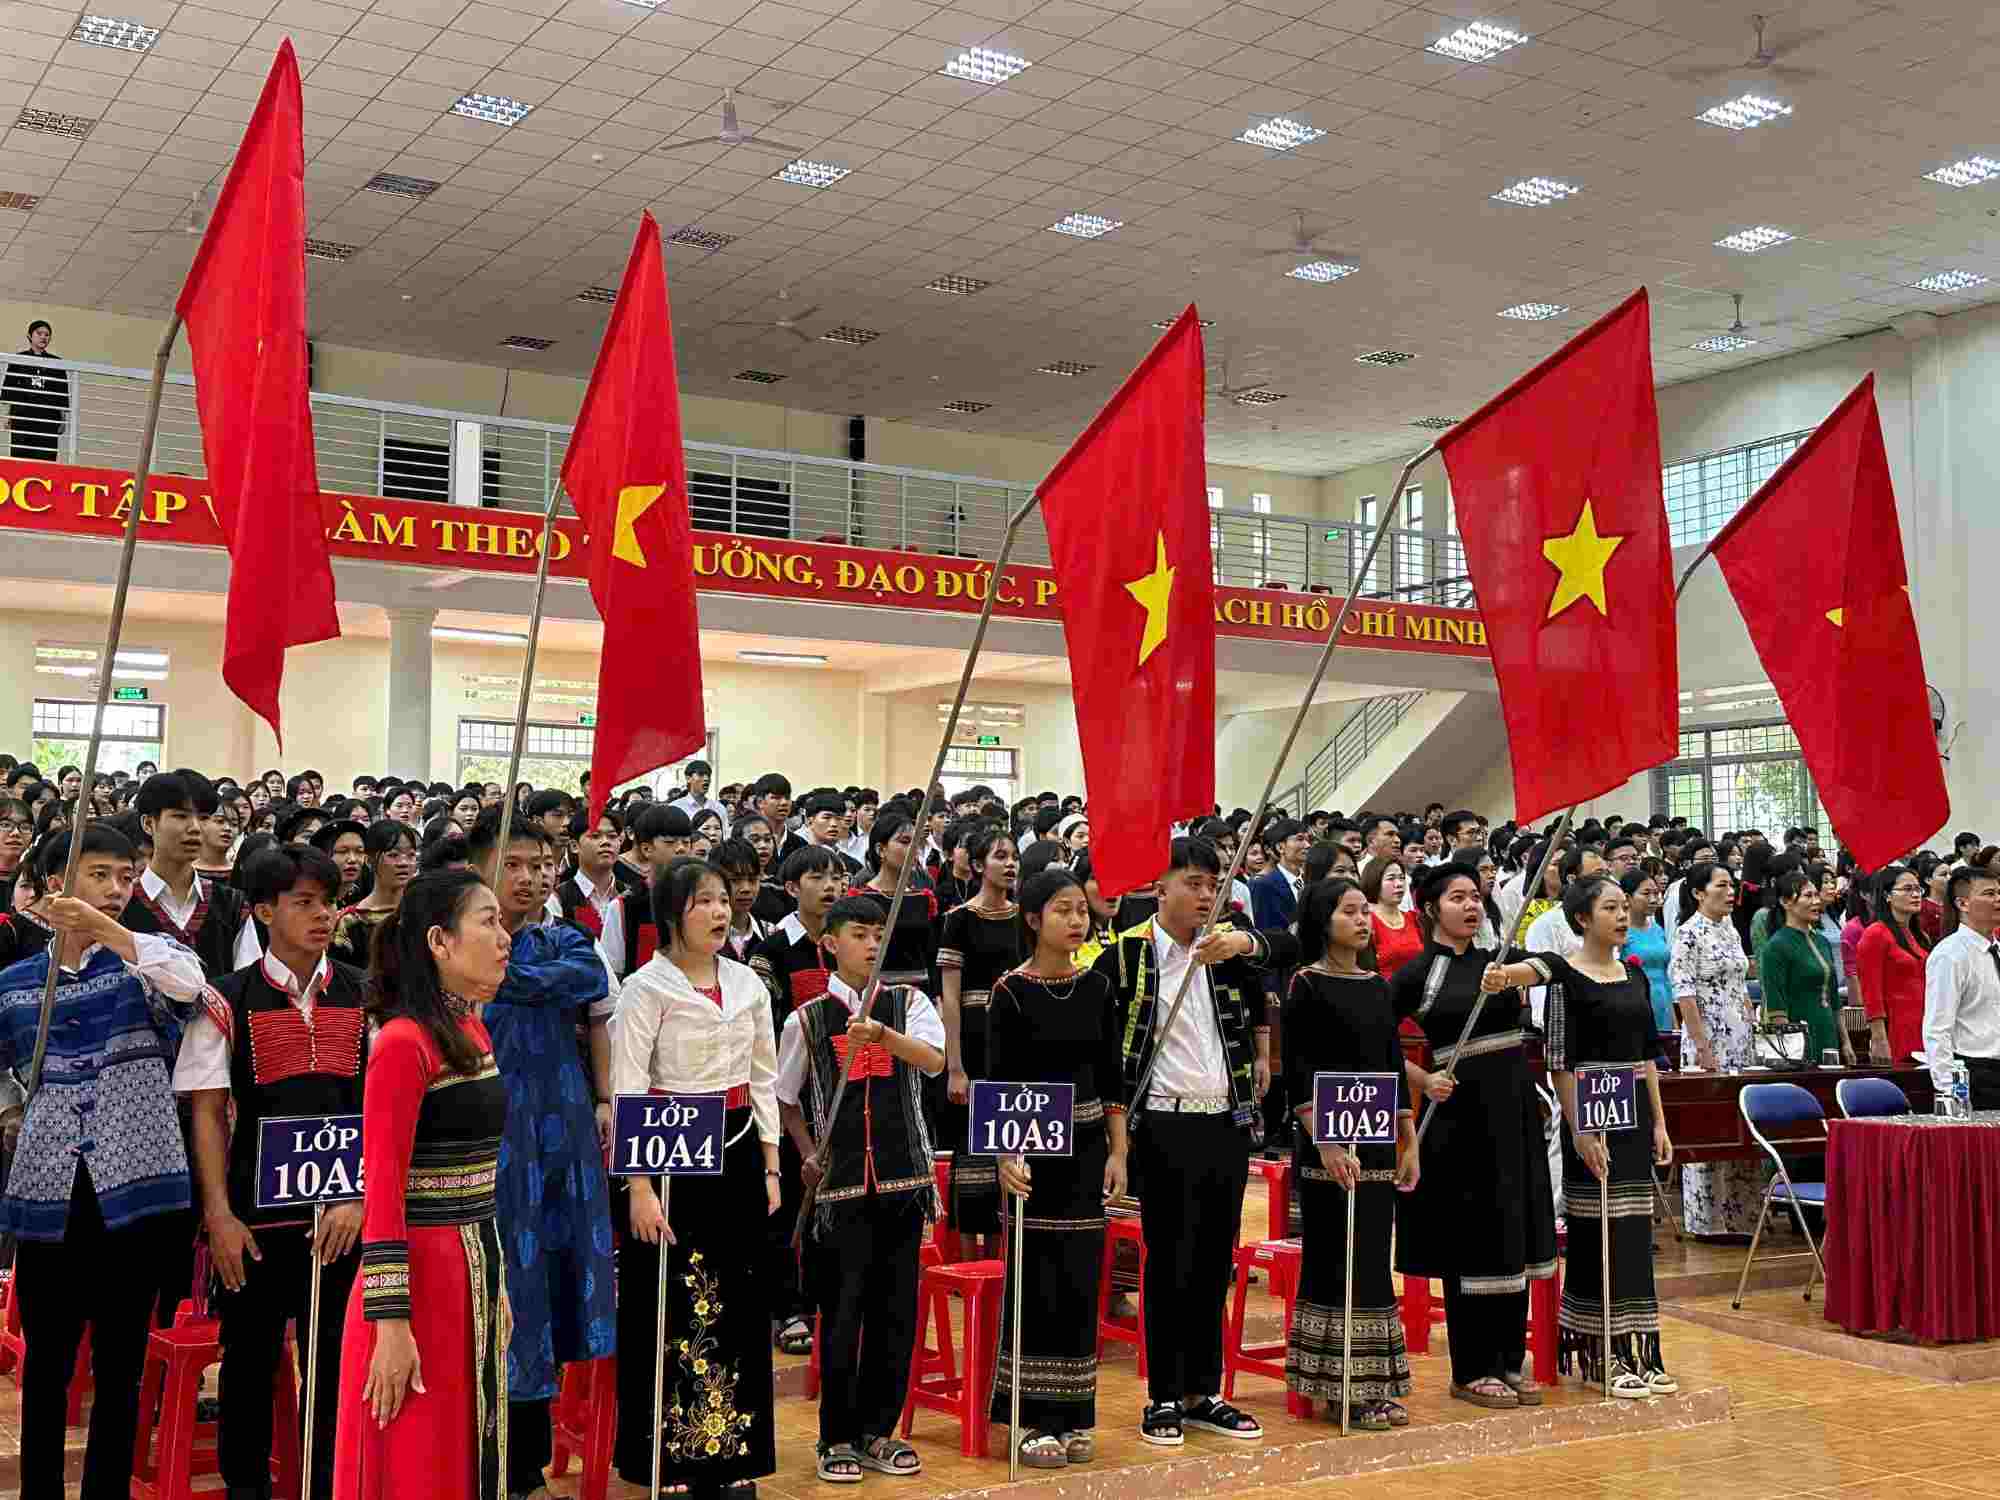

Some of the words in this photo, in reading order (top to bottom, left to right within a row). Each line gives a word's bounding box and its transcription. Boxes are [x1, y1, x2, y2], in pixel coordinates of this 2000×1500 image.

[0, 479, 52, 511] C
[71, 479, 187, 528] TẬP
[325, 500, 418, 547] ÀM
[432, 519, 571, 560] THEO
[693, 540, 823, 589] ƯỞNG,
[832, 560, 925, 597] ĐẠO
[933, 562, 1024, 607] ĐỨC,
[1280, 598, 1330, 630] HỒ
[1342, 608, 1396, 637] CHÍ
[1405, 615, 1487, 645] MINH
[1336, 1080, 1378, 1103] LỚP
[1591, 1072, 1621, 1094] LỚP
[642, 1100, 699, 1127] LỚP
[997, 1087, 1050, 1112] LỚP
[1584, 1098, 1630, 1127] 10A1
[292, 1122, 358, 1152] LỚP
[984, 1119, 1064, 1151] 10A3
[1325, 1108, 1389, 1137] 10A2
[626, 1134, 715, 1168] 10A4
